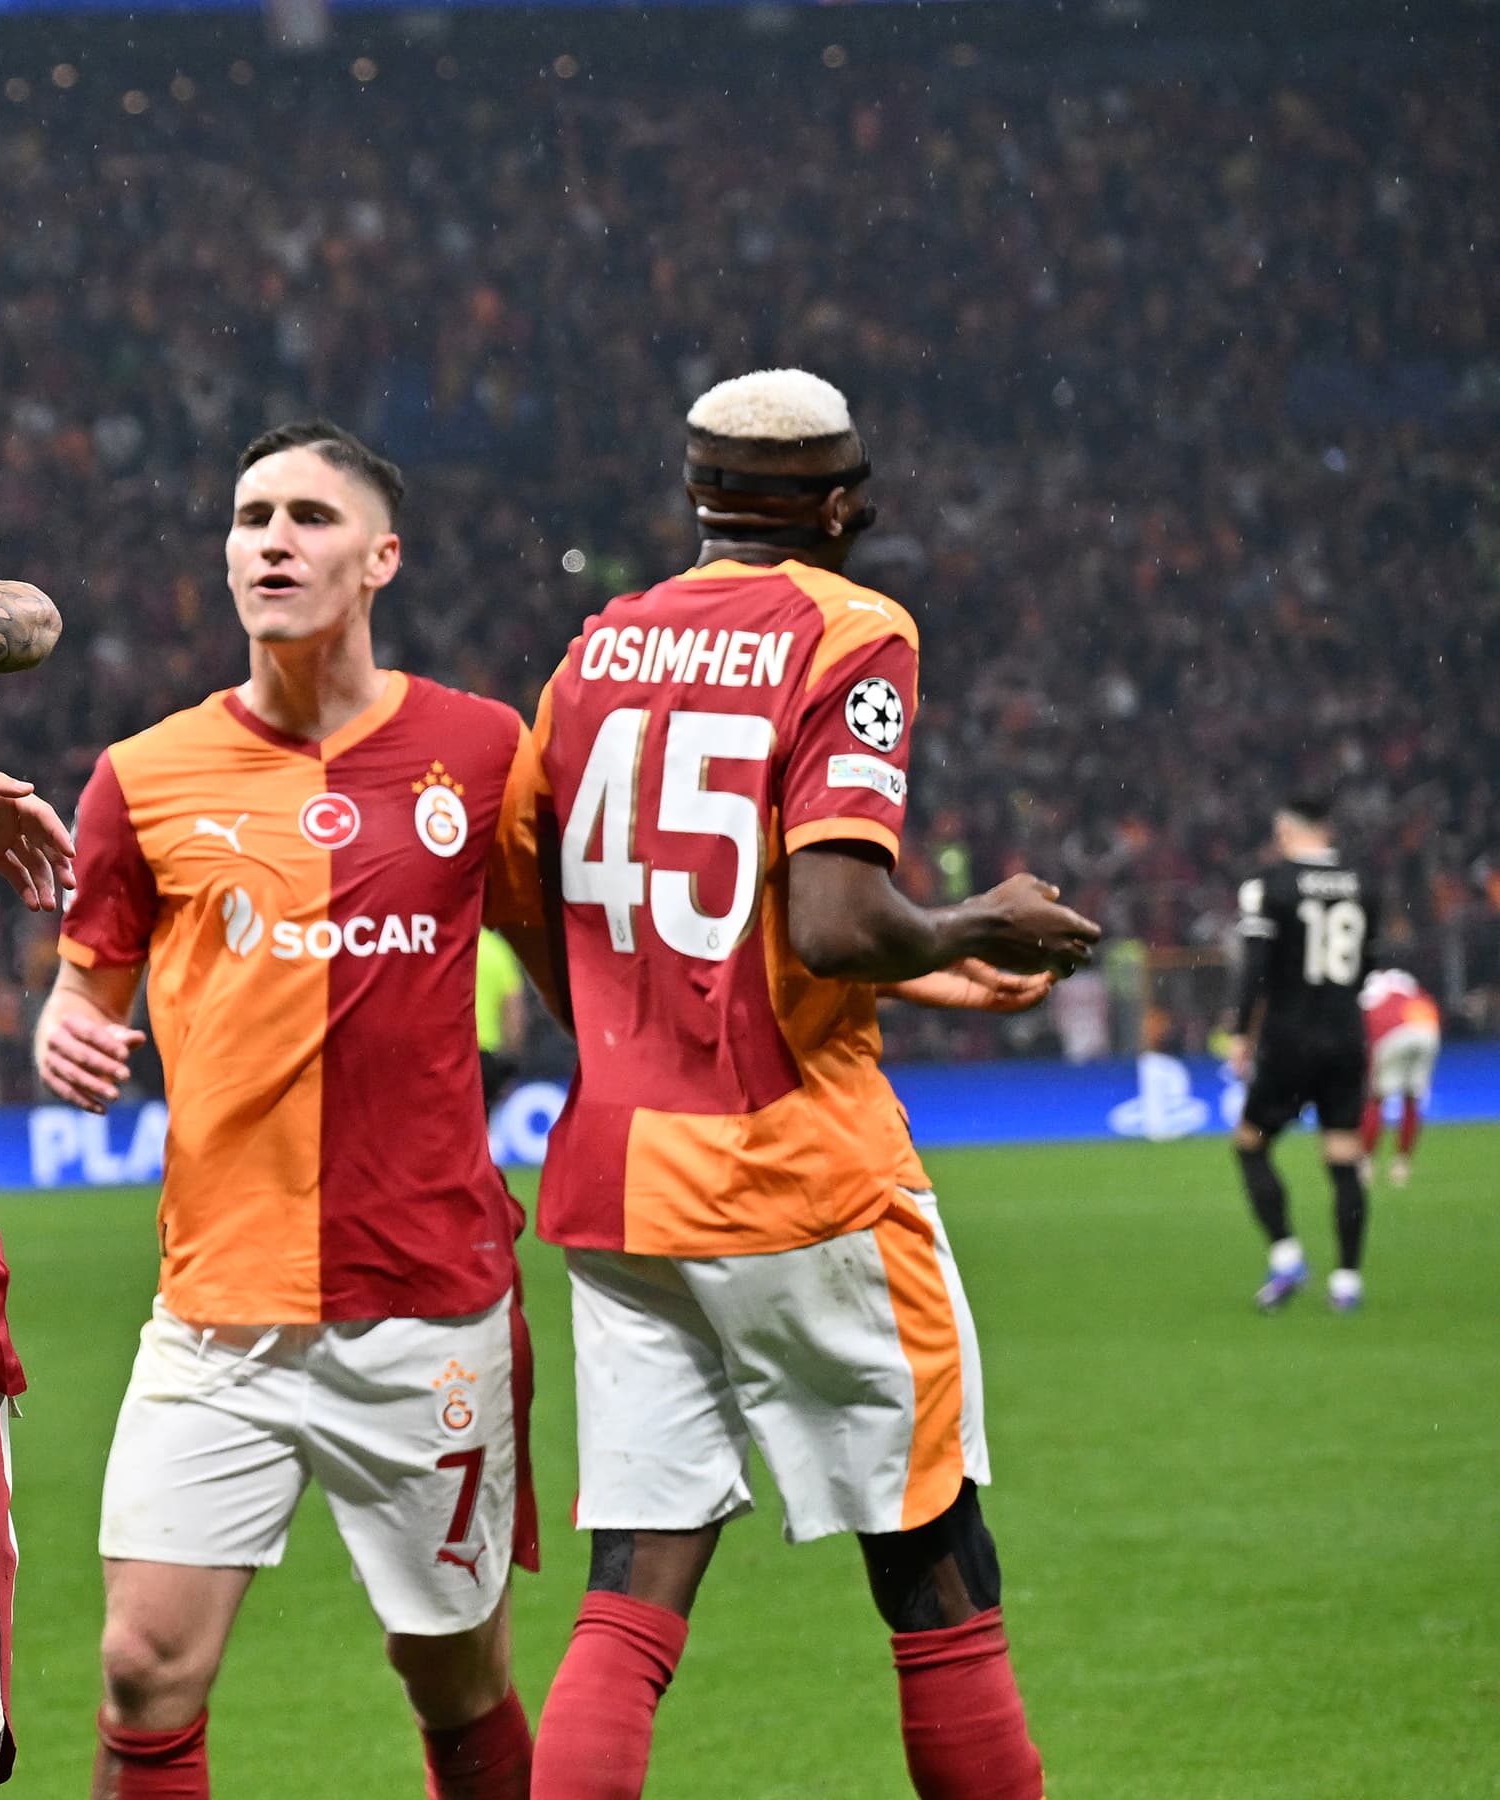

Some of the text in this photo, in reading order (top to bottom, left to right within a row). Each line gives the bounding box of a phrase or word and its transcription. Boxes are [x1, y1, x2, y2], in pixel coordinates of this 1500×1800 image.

[581, 625, 794, 688] OSIMHEN
[560, 707, 777, 962] 45
[271, 913, 437, 960] SOCAR
[1297, 899, 1367, 985] 18
[435, 1445, 486, 1543] 7
